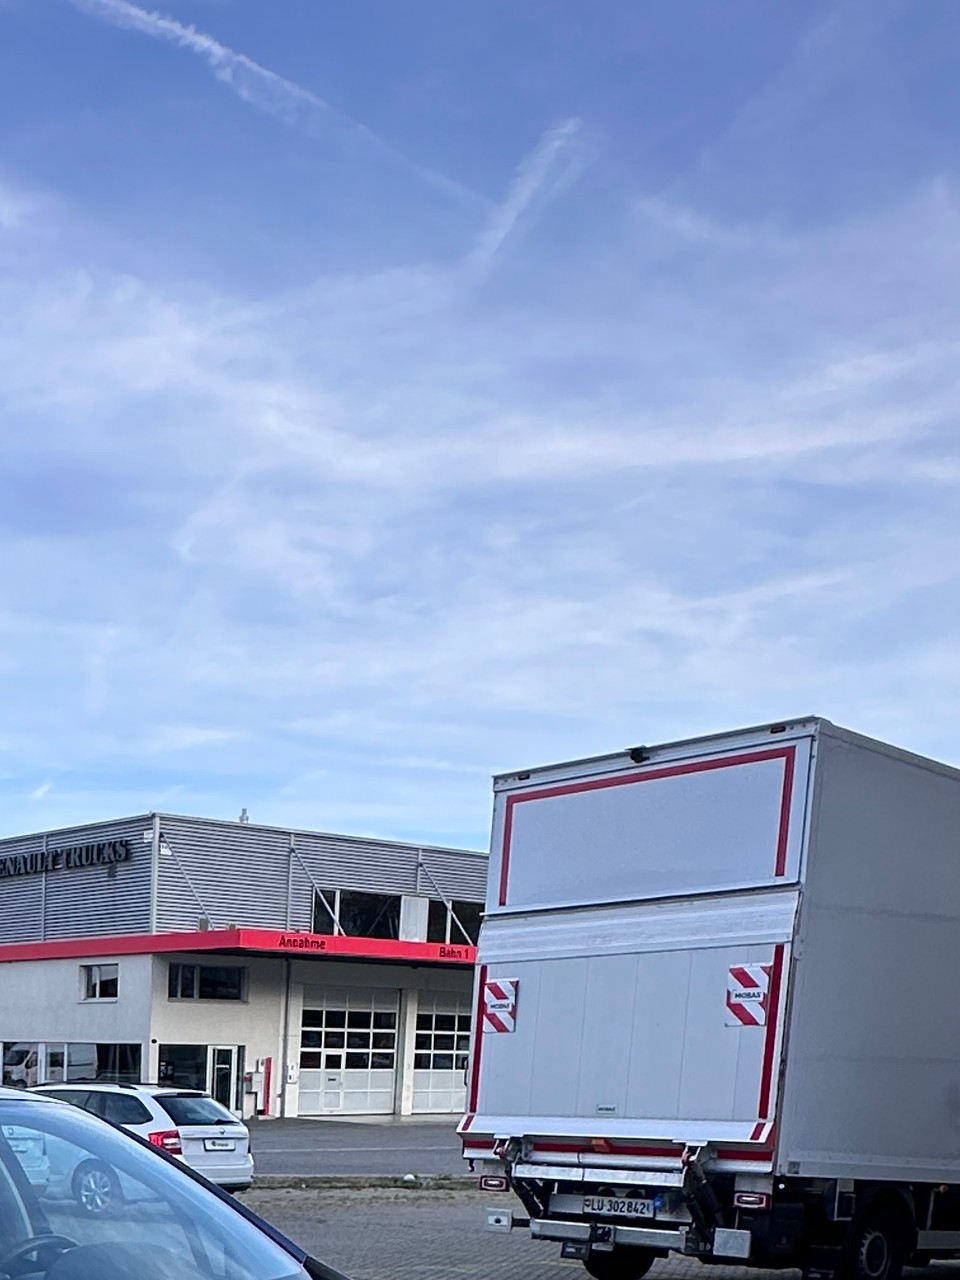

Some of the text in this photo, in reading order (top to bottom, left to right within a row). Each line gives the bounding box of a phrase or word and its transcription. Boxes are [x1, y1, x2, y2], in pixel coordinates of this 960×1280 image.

[62, 840, 128, 870] TRUCKS
[279, 935, 326, 949] Annahme
[439, 947, 469, 959] Bahn 1
[591, 1199, 646, 1214] LU 302842
